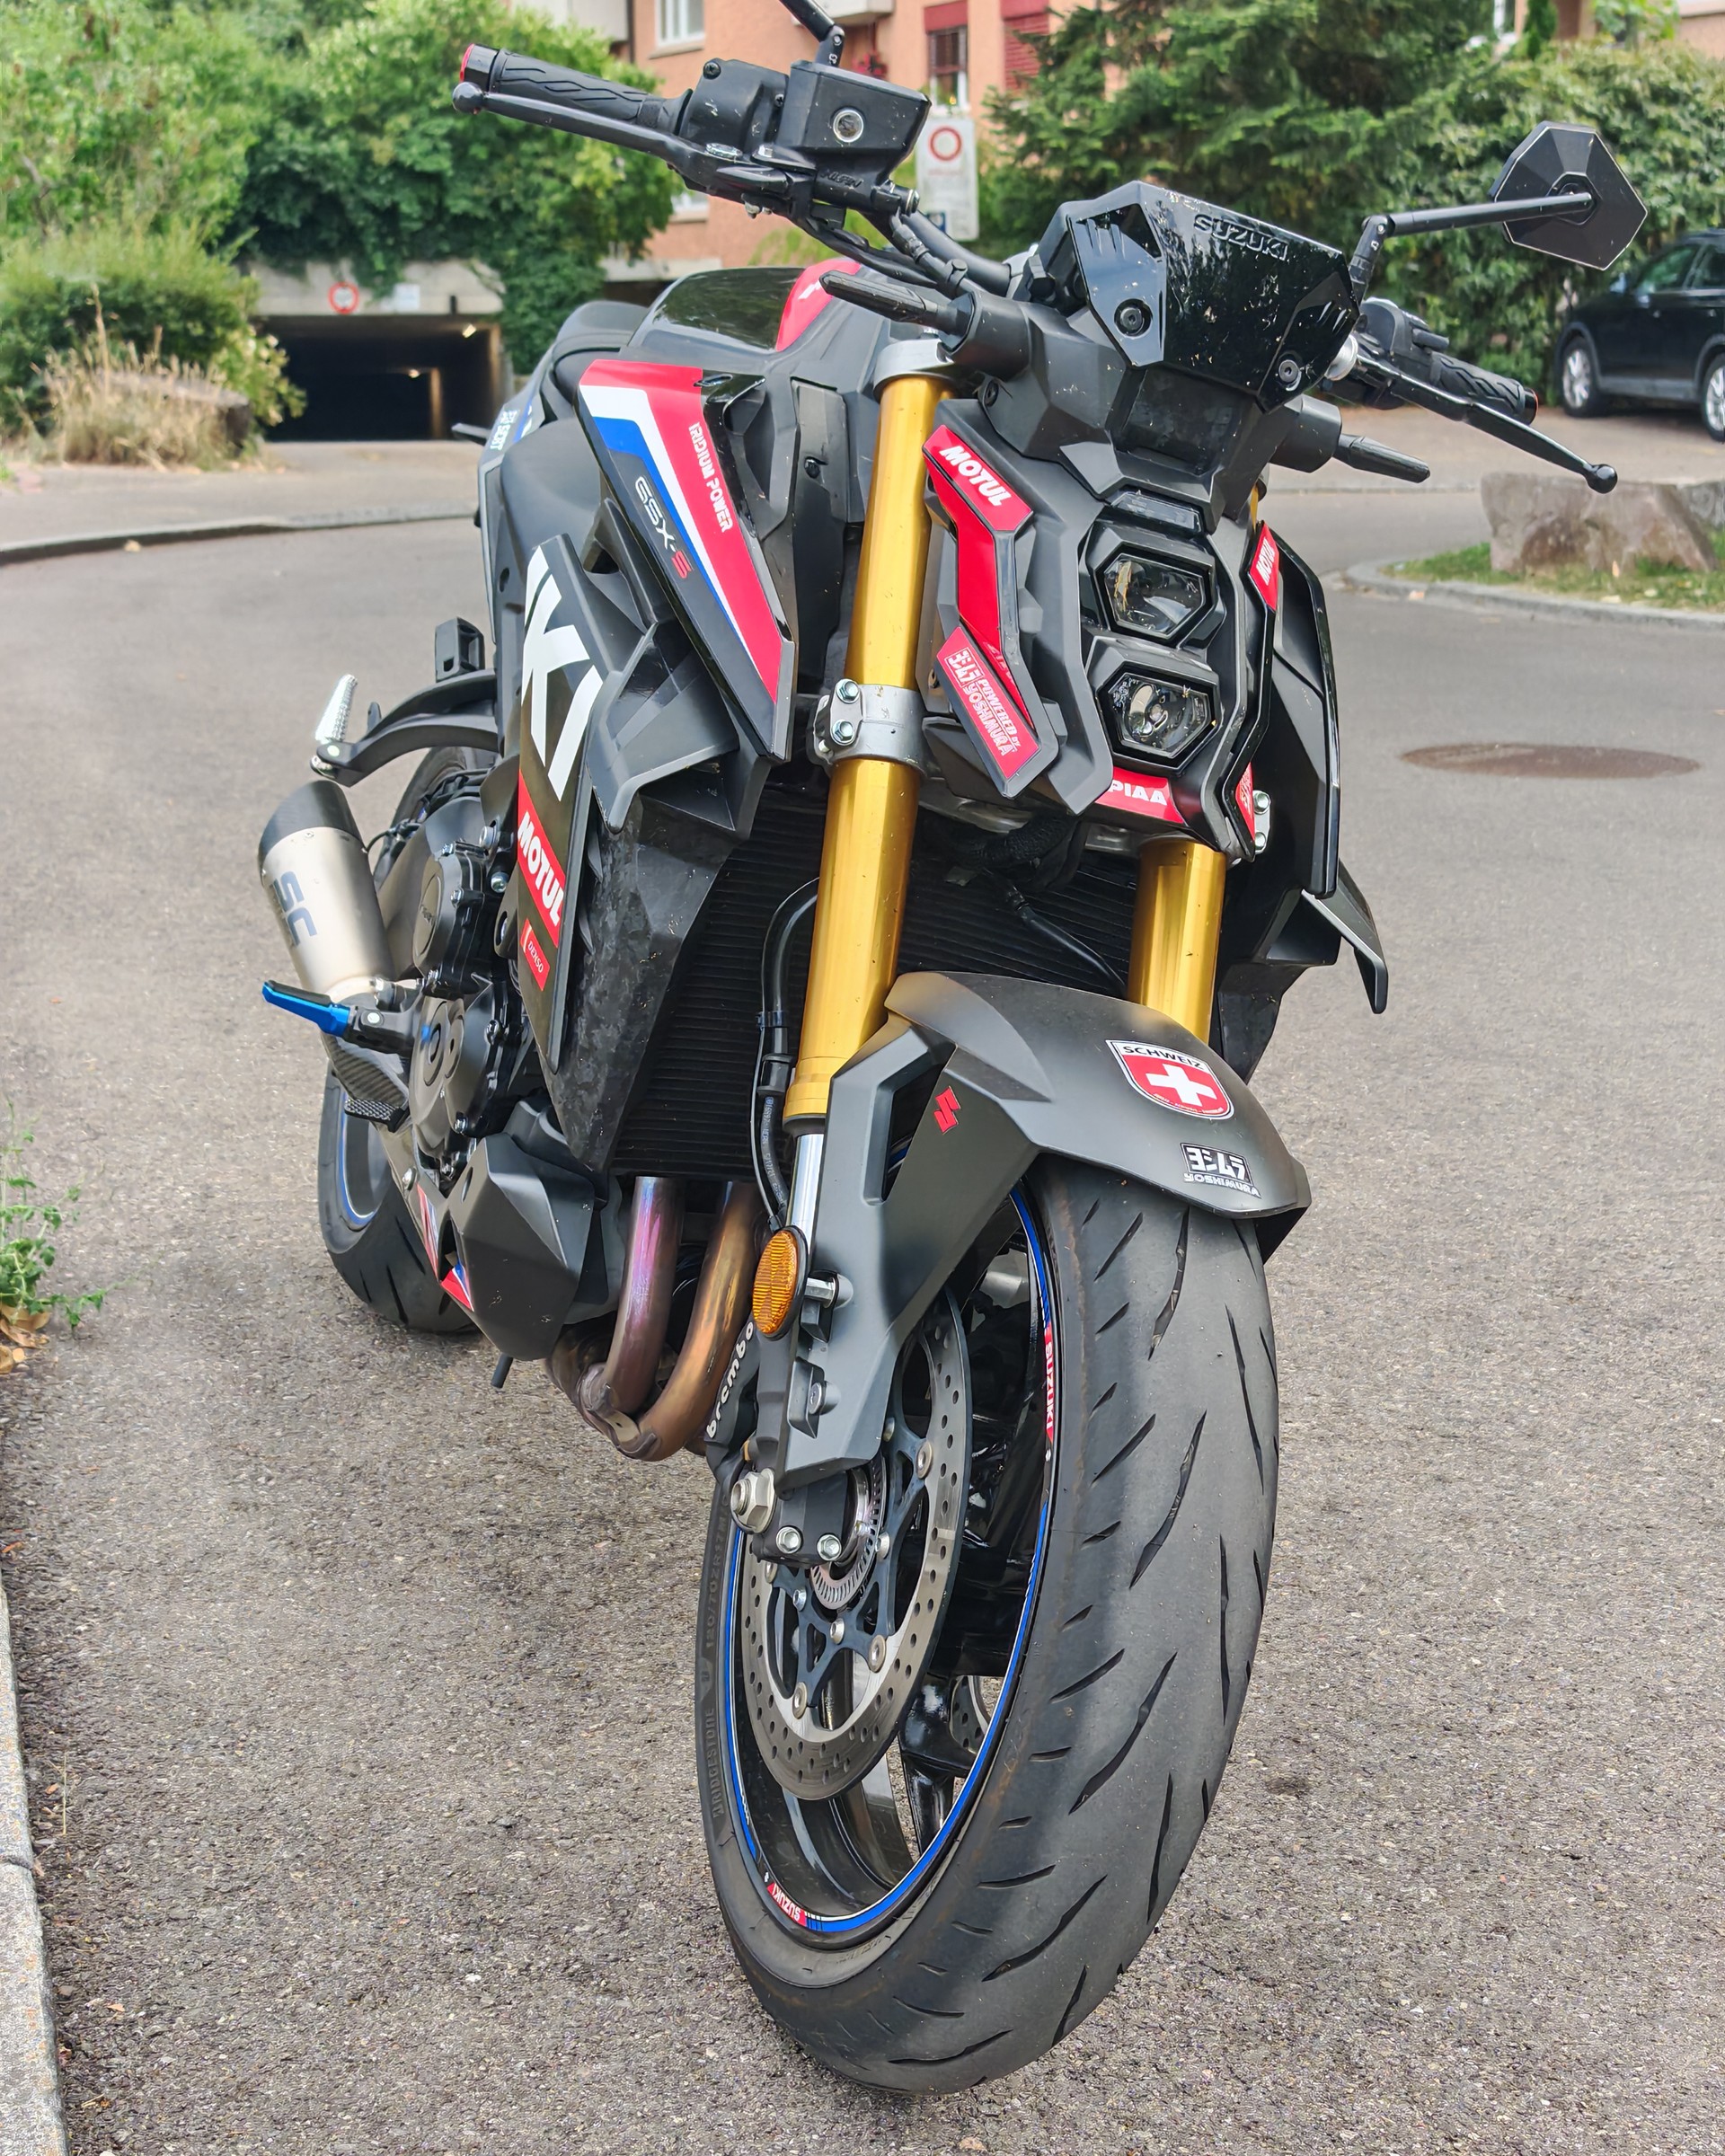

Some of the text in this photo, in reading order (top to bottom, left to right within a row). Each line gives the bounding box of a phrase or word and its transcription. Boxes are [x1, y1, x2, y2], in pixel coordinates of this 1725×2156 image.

[1194, 214, 1288, 261] SUZUKI
[688, 421, 733, 533] IRIDIUM POWER
[939, 446, 1012, 506] MOTUL
[635, 476, 693, 579] GSX-S
[1256, 536, 1276, 587] MOTUL
[962, 683, 1014, 756] YOSHIMURA
[978, 678, 1018, 735] POWERED
[1108, 779, 1167, 806] PIAA
[518, 810, 564, 926] MOTUL
[273, 870, 317, 947] SC
[527, 940, 544, 974] DENSO
[1122, 1046, 1205, 1070] SCHWEIZ
[1183, 1172, 1261, 1198] YOSHIMURA
[706, 1321, 754, 1438] brembo
[1045, 1341, 1055, 1430] SUZUKI
[704, 1708, 725, 1818] BRIDGESTONE
[772, 1882, 801, 1922] SUZUKI
